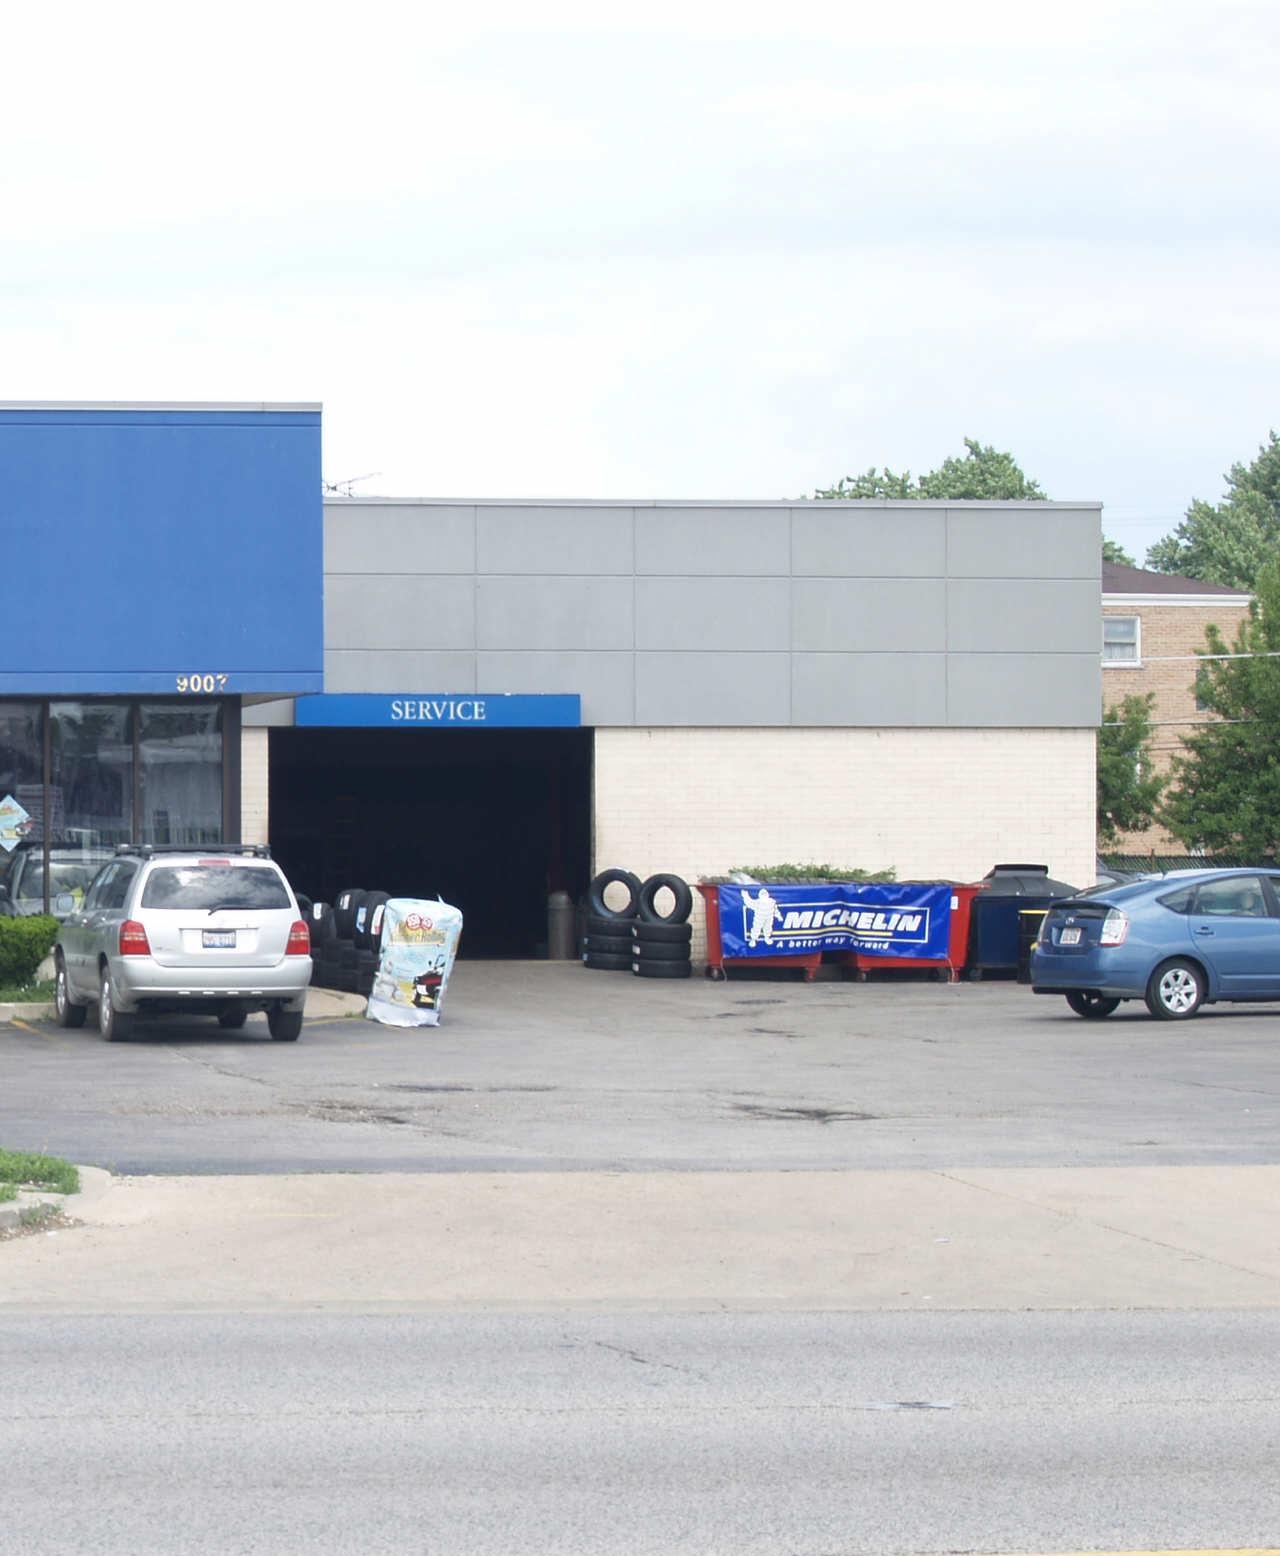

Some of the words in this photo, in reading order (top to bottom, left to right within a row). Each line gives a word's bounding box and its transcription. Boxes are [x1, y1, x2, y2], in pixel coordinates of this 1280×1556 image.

[391, 700, 486, 720] SERVICE
[783, 909, 922, 931] MICHELIN
[775, 940, 784, 949] A
[788, 938, 822, 949] better
[824, 936, 847, 946] way
[849, 937, 890, 951] forward
